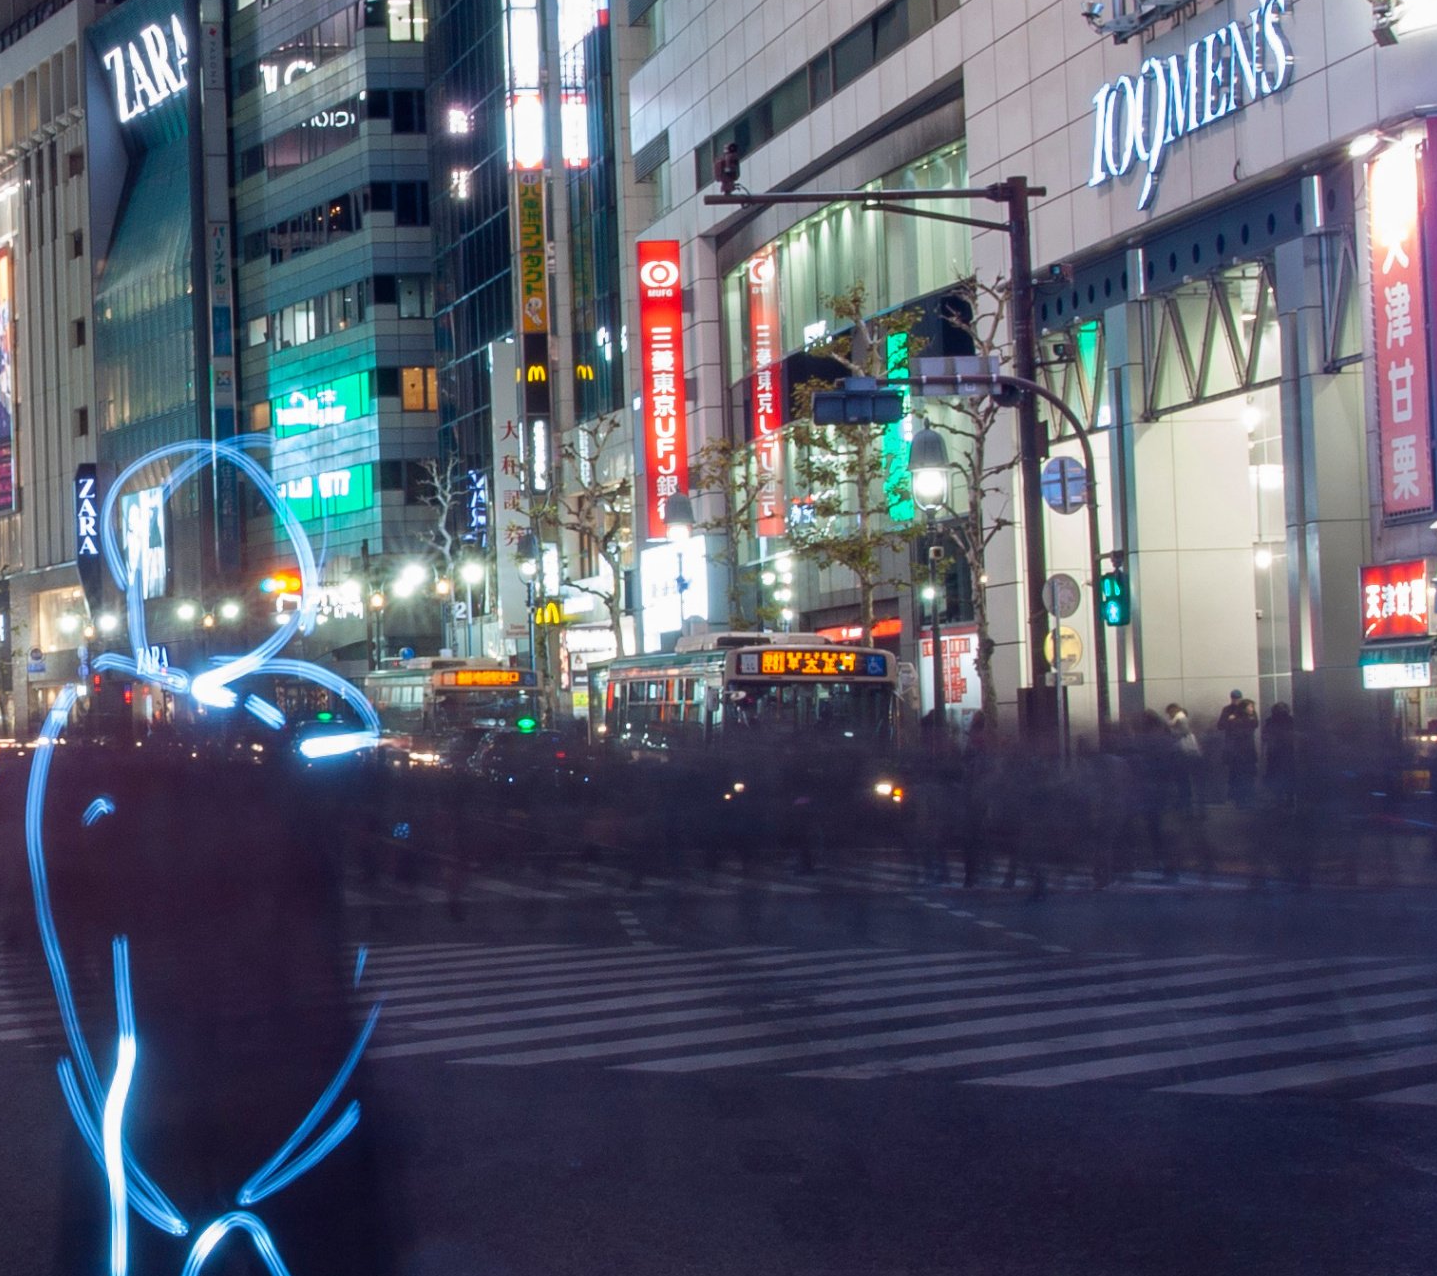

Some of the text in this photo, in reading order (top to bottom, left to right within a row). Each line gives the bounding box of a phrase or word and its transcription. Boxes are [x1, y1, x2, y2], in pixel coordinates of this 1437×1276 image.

[103, 13, 189, 123] ZARA
[647, 288, 673, 297] MUFG
[78, 479, 98, 555] ZARA
[137, 646, 169, 675] ZARA
